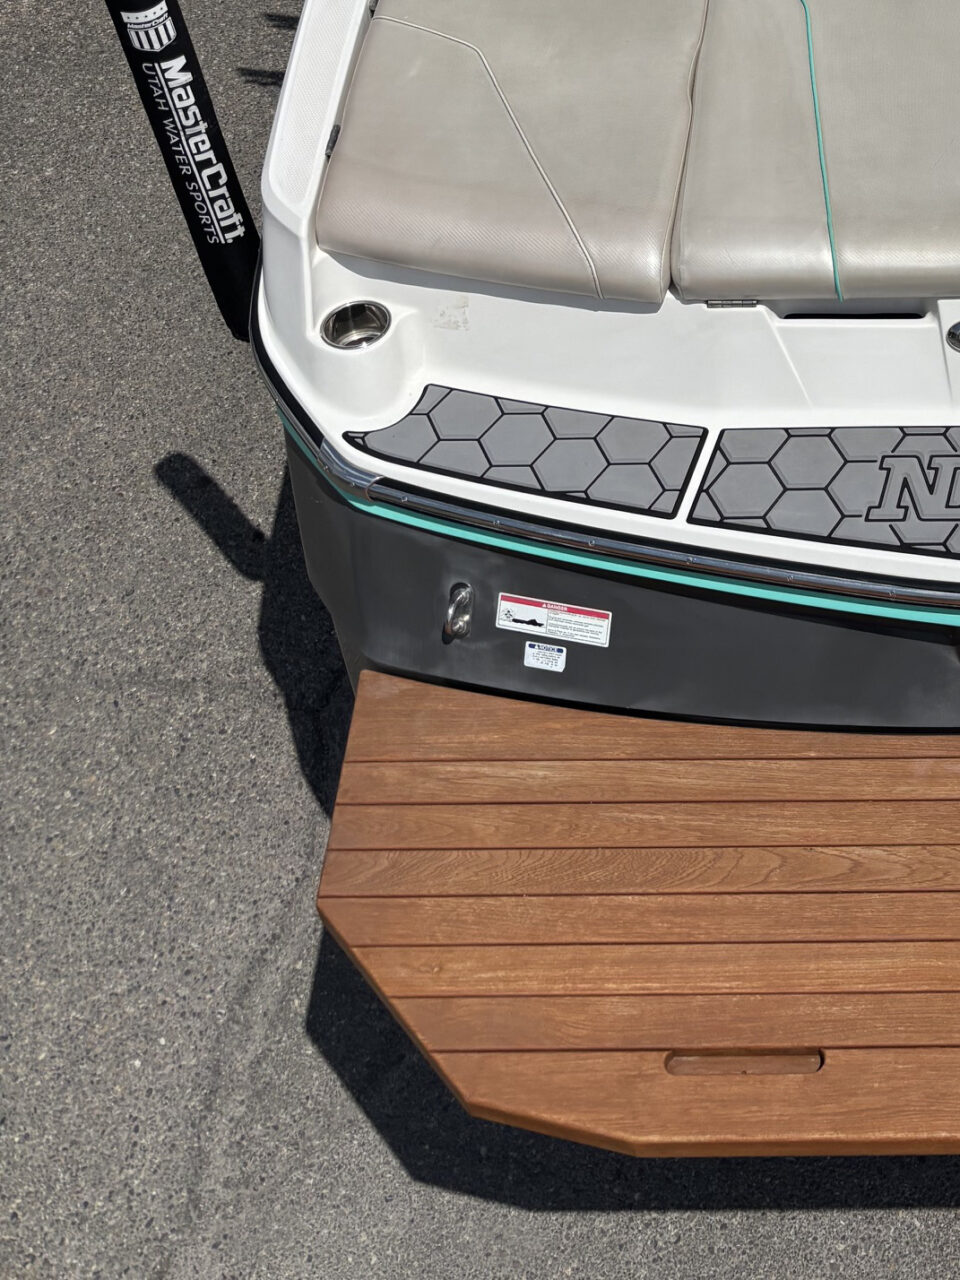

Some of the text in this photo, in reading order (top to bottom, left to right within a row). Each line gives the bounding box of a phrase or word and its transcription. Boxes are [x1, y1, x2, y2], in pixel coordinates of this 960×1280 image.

[142, 62, 220, 244] UTAH WATER SPORTS
[160, 54, 246, 241] MasterCraft
